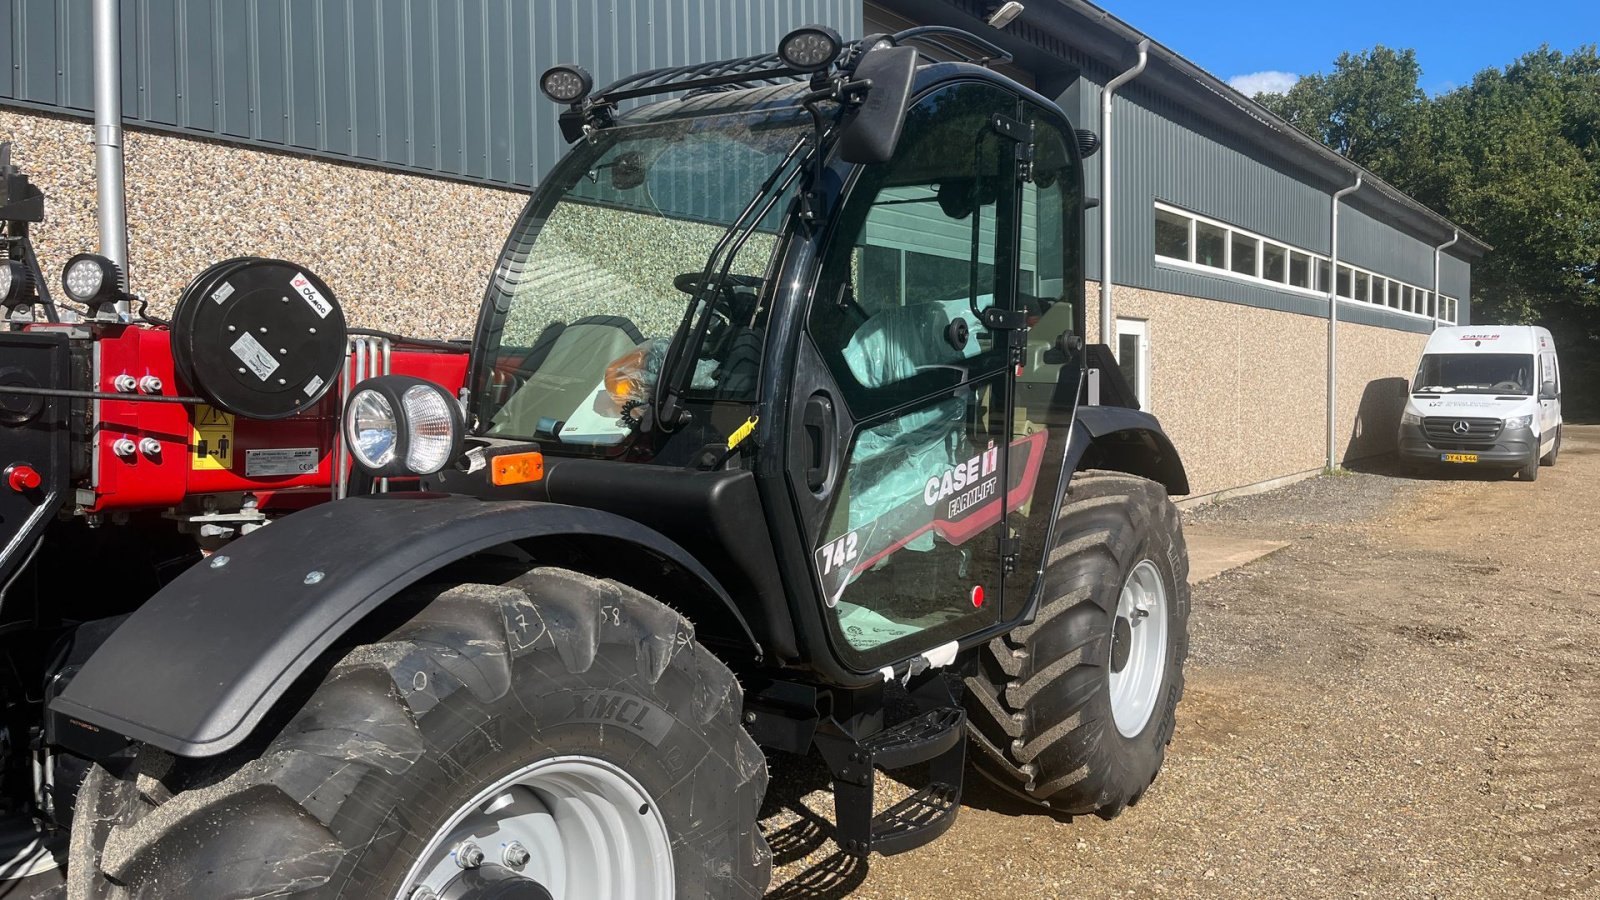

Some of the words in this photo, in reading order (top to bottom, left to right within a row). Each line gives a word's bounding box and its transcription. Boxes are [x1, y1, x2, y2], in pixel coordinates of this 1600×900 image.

[303, 287, 326, 314] domac
[923, 456, 980, 506] CASE
[948, 476, 997, 519] FARMLIFT
[822, 531, 858, 576] 742
[600, 605, 620, 627] 58
[566, 694, 651, 731] XMCL
